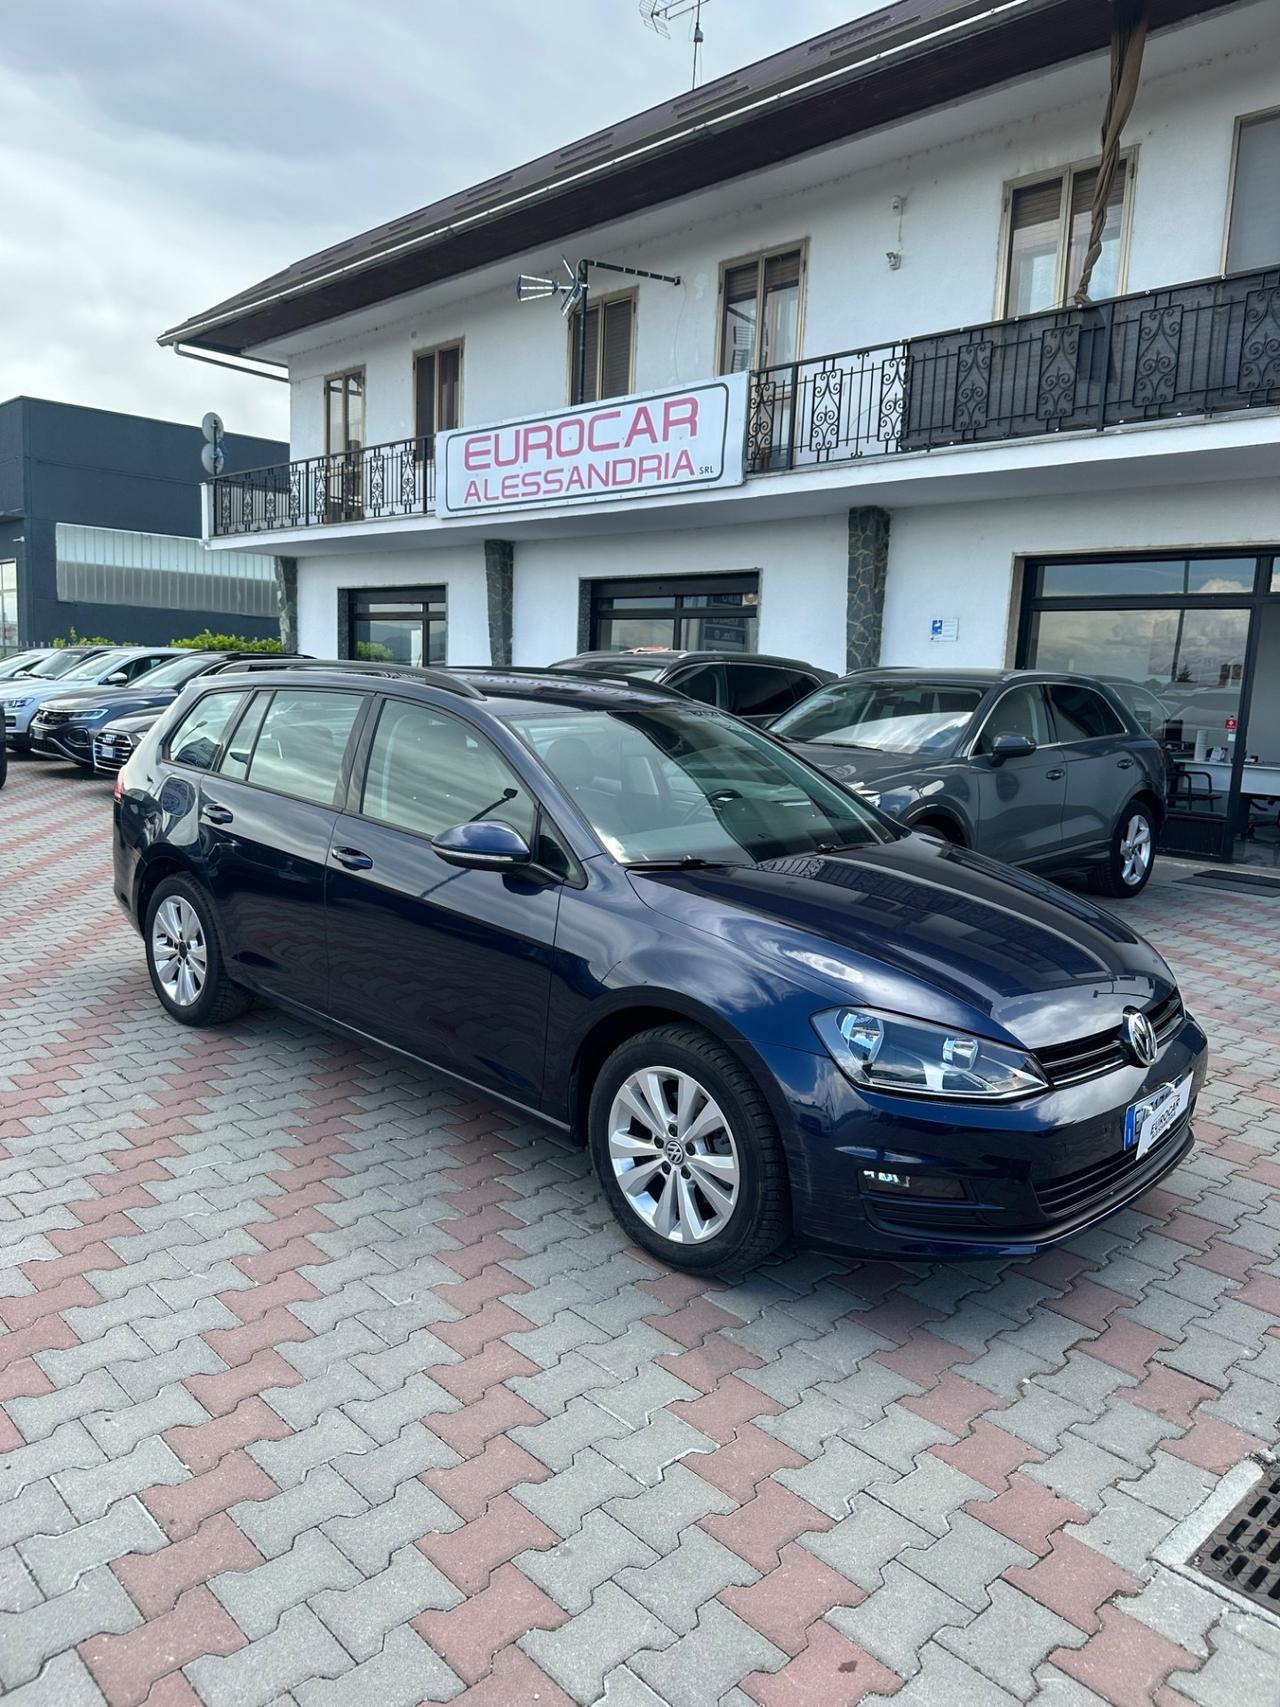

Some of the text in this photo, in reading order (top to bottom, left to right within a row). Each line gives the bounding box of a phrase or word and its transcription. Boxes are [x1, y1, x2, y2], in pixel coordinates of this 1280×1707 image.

[464, 396, 699, 472] EUROCAR
[464, 449, 714, 504] ALESSANDRIA SRL
